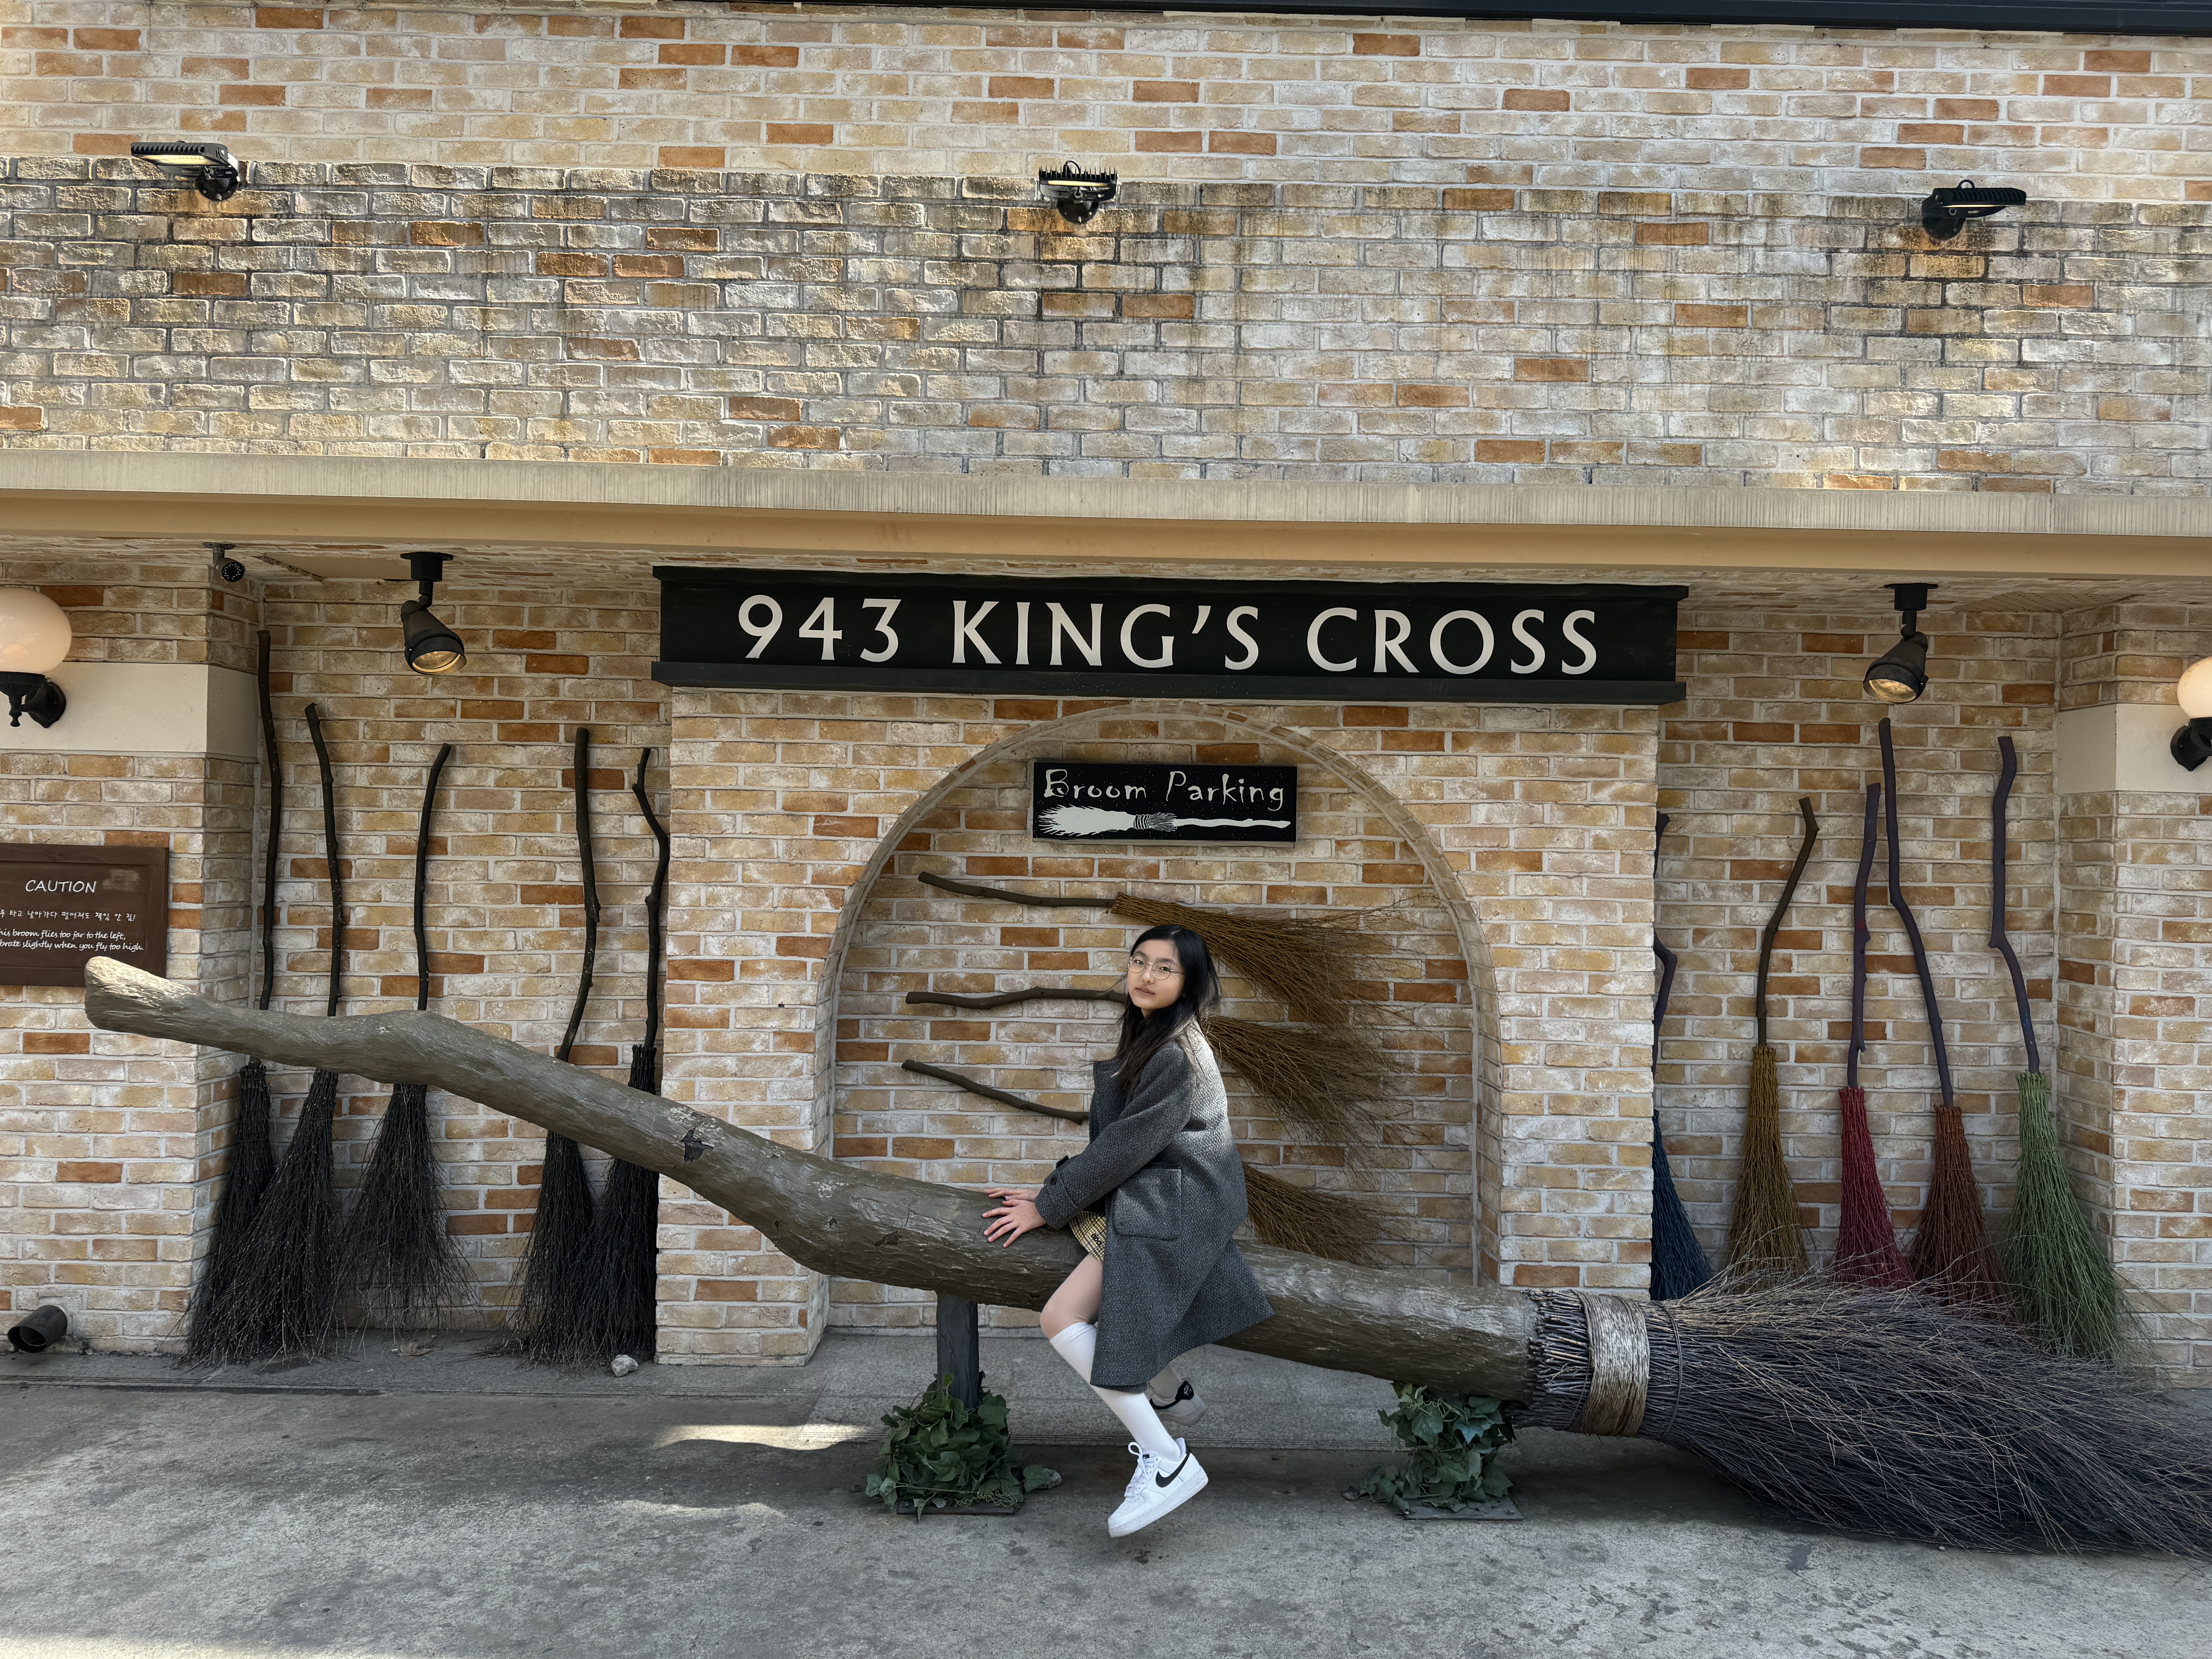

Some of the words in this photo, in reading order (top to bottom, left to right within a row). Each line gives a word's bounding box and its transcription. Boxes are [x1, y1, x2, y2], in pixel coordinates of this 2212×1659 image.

[738, 594, 902, 662] 943
[952, 600, 1259, 670] KING'S
[1307, 607, 1596, 675] CROSS
[1044, 769, 1146, 800] Broom
[1166, 771, 1283, 811] Parking
[25, 880, 96, 893] CAUTION
[27, 910, 58, 919] 날아가다
[61, 912, 90, 920] 떨어져도
[95, 912, 110, 921] 책임
[126, 913, 136, 922] 짐!
[12, 928, 40, 937] broom
[40, 929, 58, 939] flies
[72, 931, 85, 940] far
[110, 931, 125, 941] left,
[22, 940, 53, 950] slightly
[94, 942, 108, 951] fly
[122, 942, 144, 952] high.
